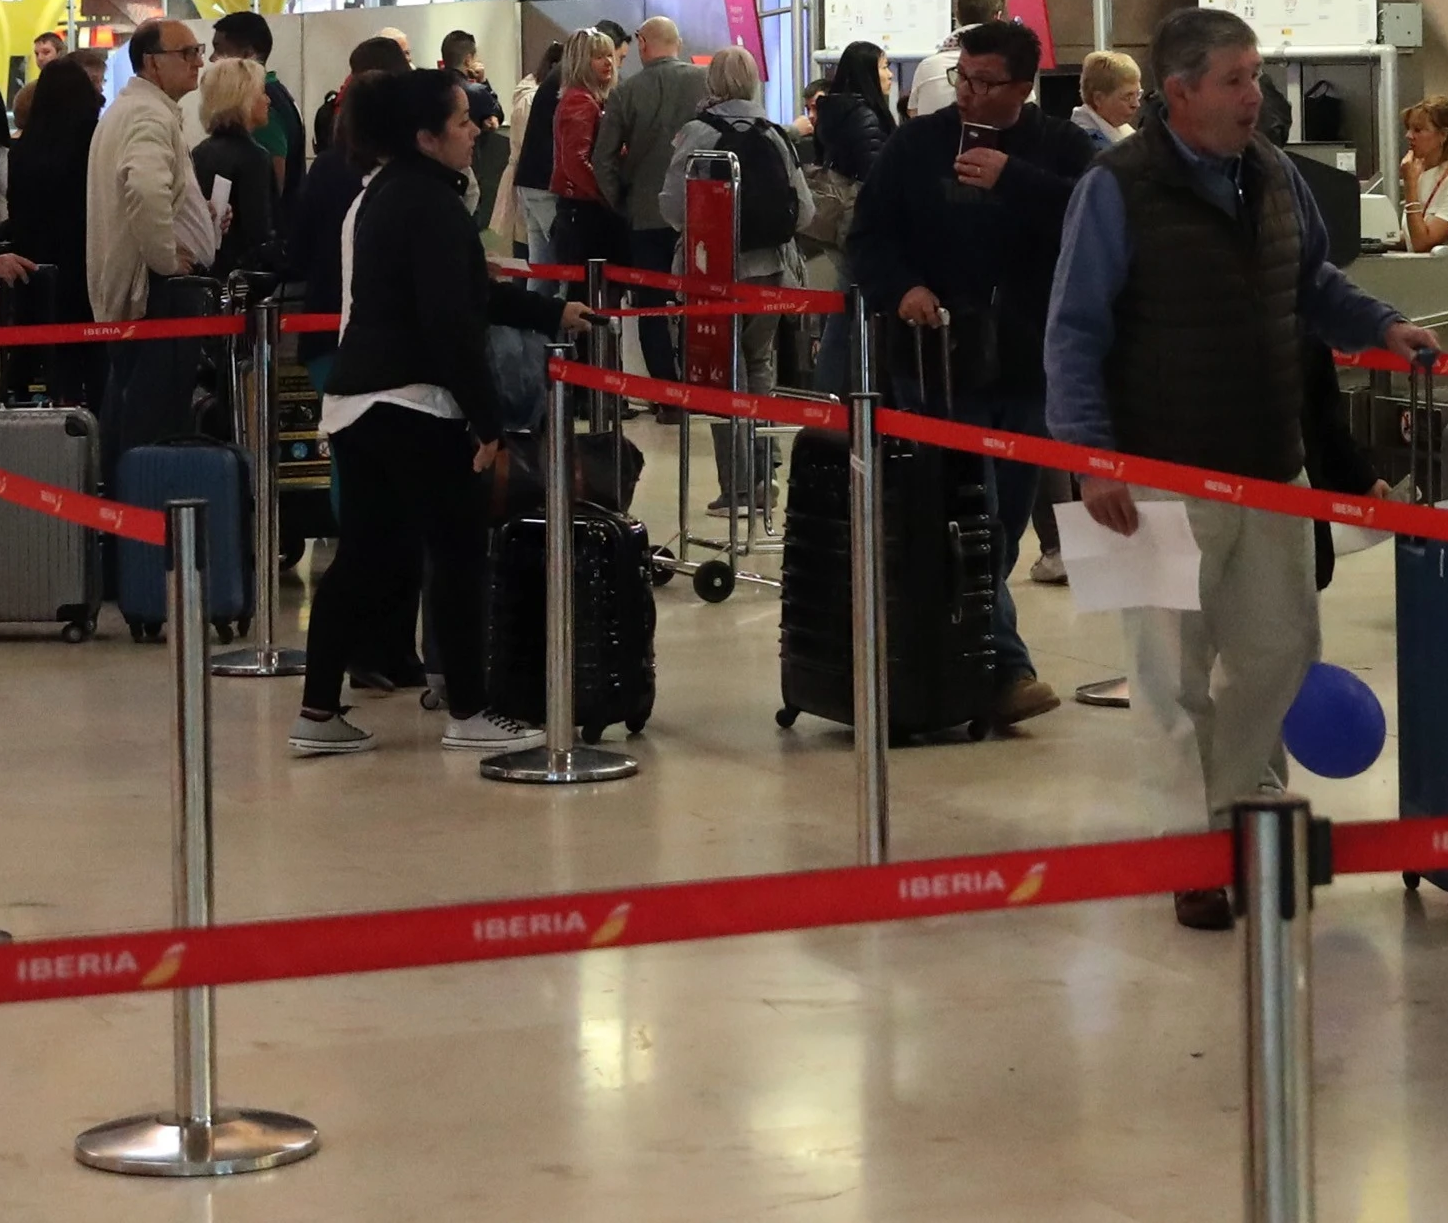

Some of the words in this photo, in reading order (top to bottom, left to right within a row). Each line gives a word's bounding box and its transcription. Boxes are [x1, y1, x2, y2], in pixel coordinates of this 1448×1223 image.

[763, 301, 796, 313] IBERIA
[83, 327, 121, 337] IBERIA
[982, 437, 1007, 451] IBERIA
[1088, 456, 1115, 471] IBERIA
[1203, 479, 1233, 494] IBERIA
[1332, 502, 1363, 519] IBERIA
[898, 868, 1006, 900] IBERIA
[472, 909, 587, 941] IBERIA
[17, 949, 137, 981] IBERIA
